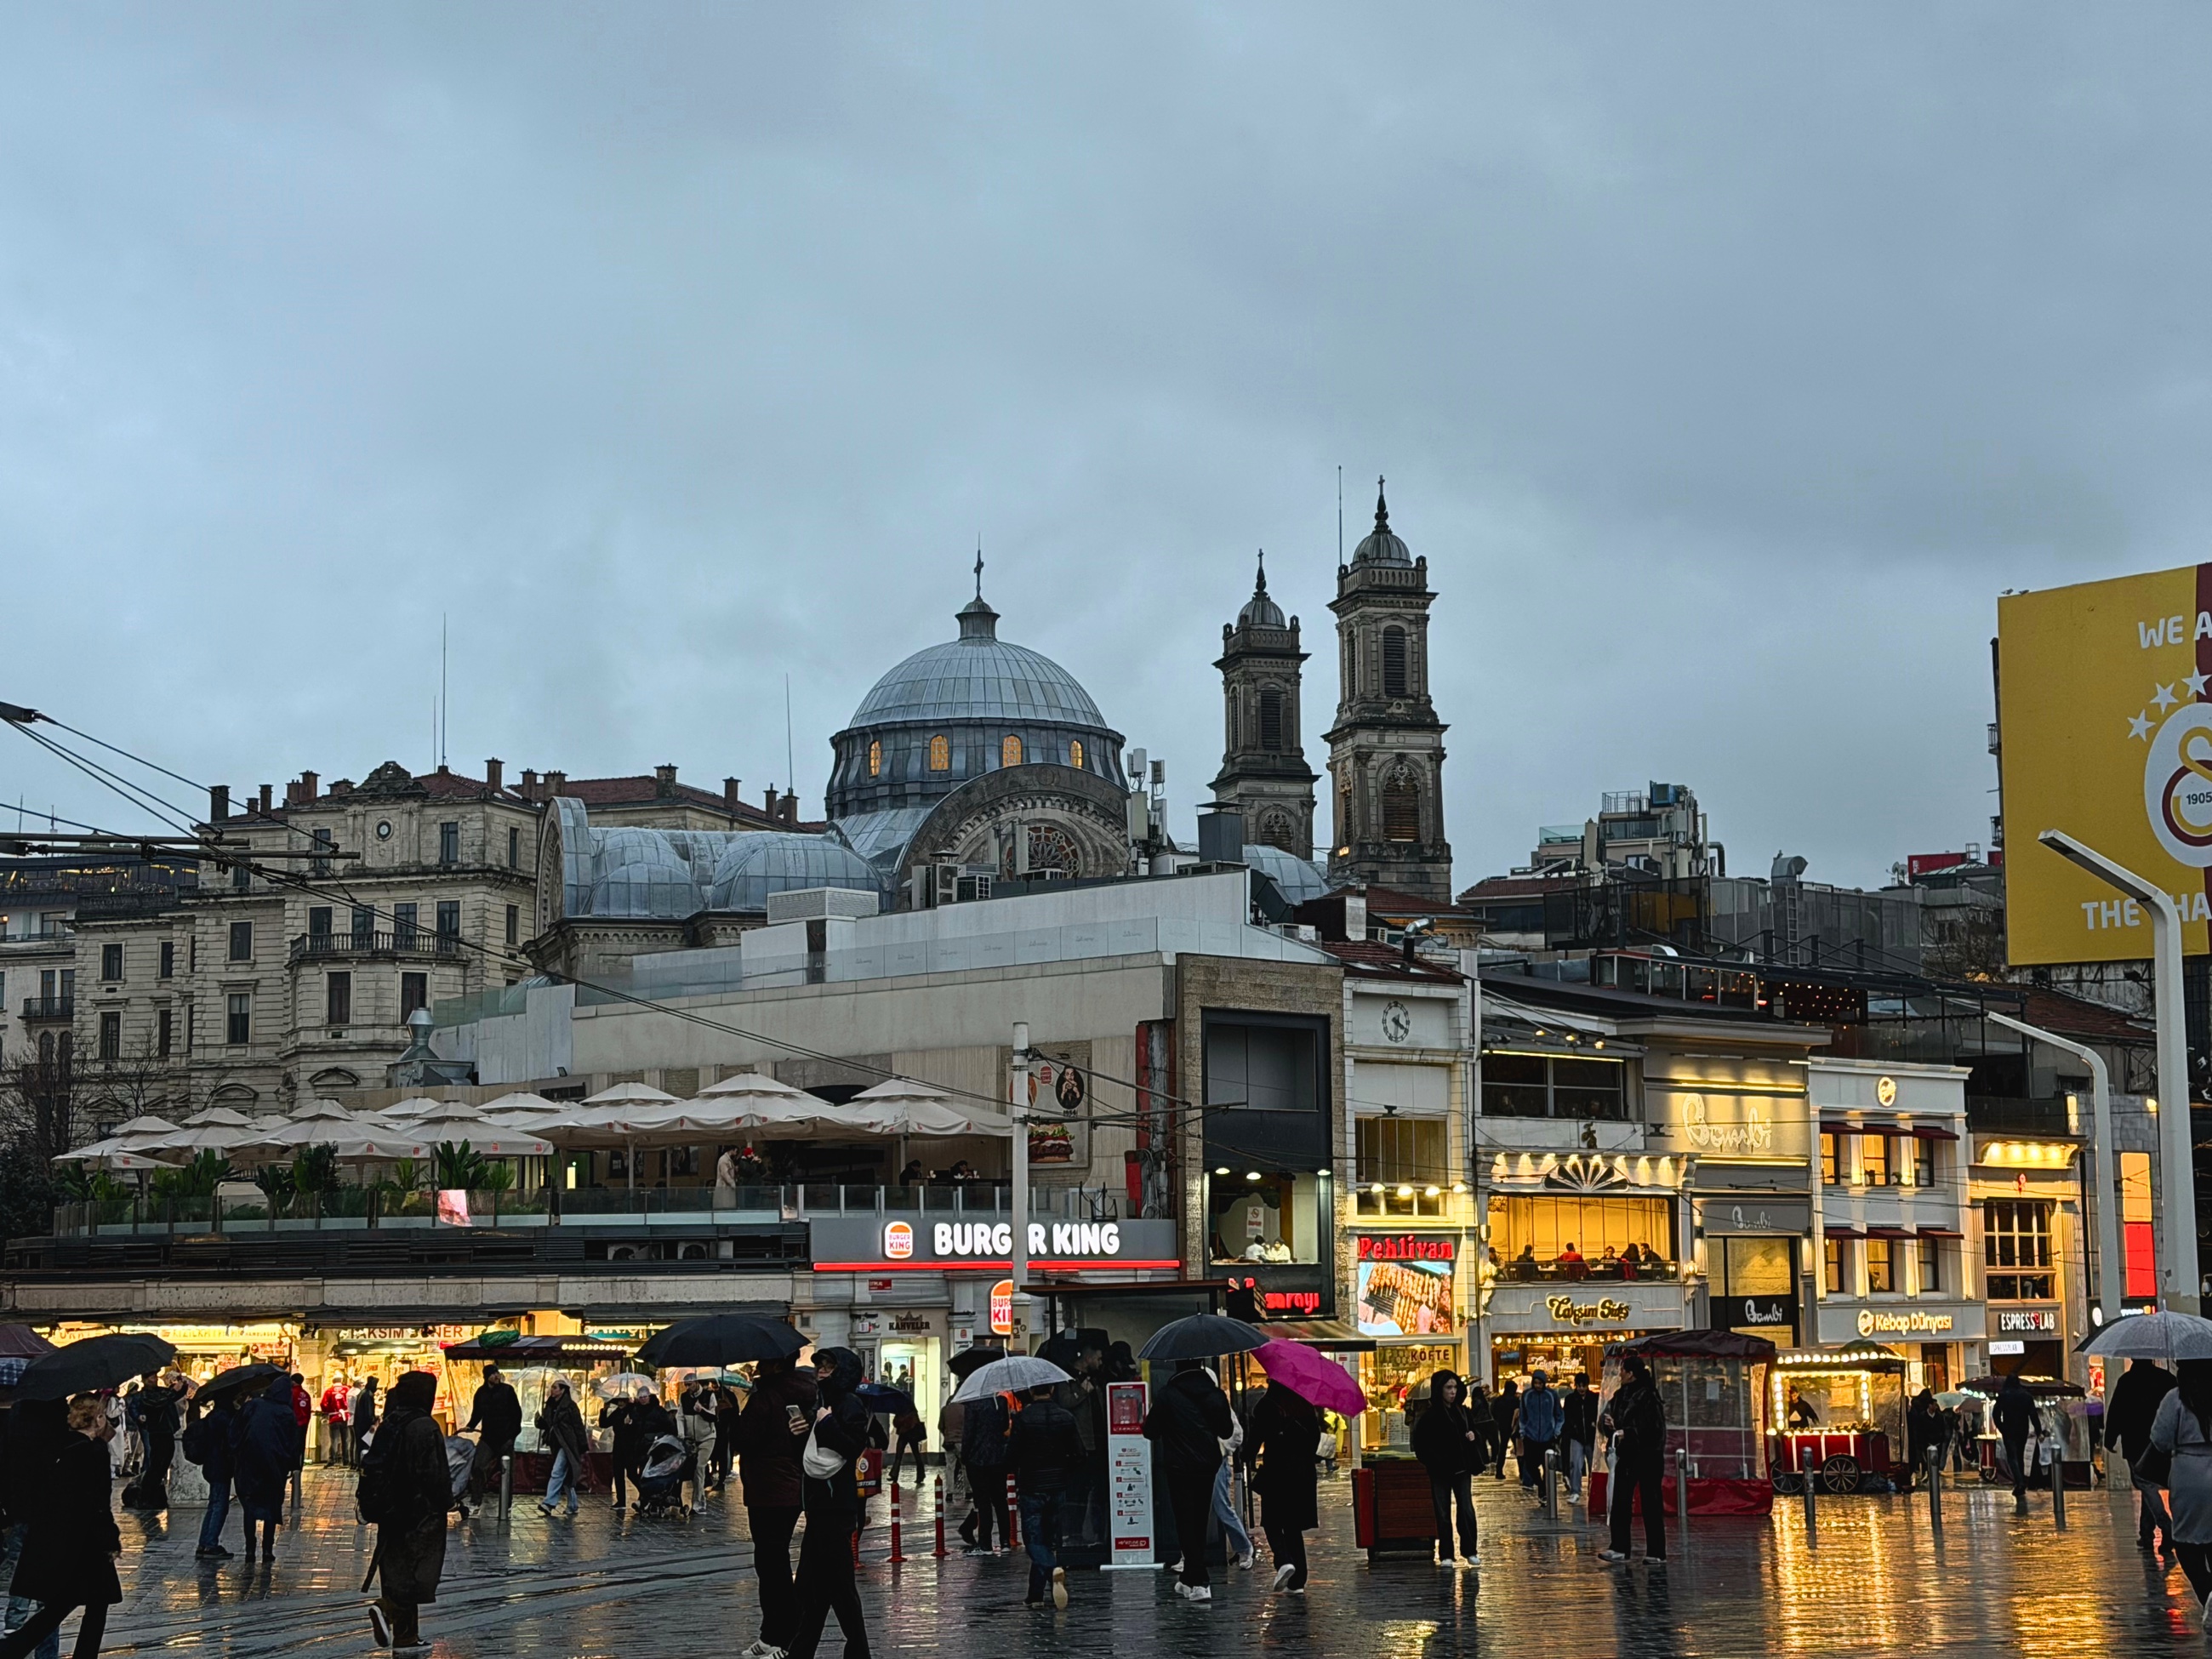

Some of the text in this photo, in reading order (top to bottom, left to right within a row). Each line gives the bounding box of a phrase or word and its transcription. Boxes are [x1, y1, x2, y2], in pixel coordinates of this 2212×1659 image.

[2138, 615, 2183, 649] WE
[2081, 898, 2141, 930] THE
[1682, 1092, 1772, 1149] Bambi
[1732, 1205, 1771, 1229] Bambi
[889, 1240, 911, 1251] KING
[933, 1223, 1120, 1256] BURGR KING
[1358, 1234, 1453, 1259] Pehlivan
[1745, 1298, 1783, 1324] Bambi
[1875, 1312, 1910, 1336] Kebap
[1910, 1310, 1953, 1335] Dünyası
[888, 1321, 931, 1331] KAHVELER
[1411, 1348, 1450, 1361] KÖFTE
